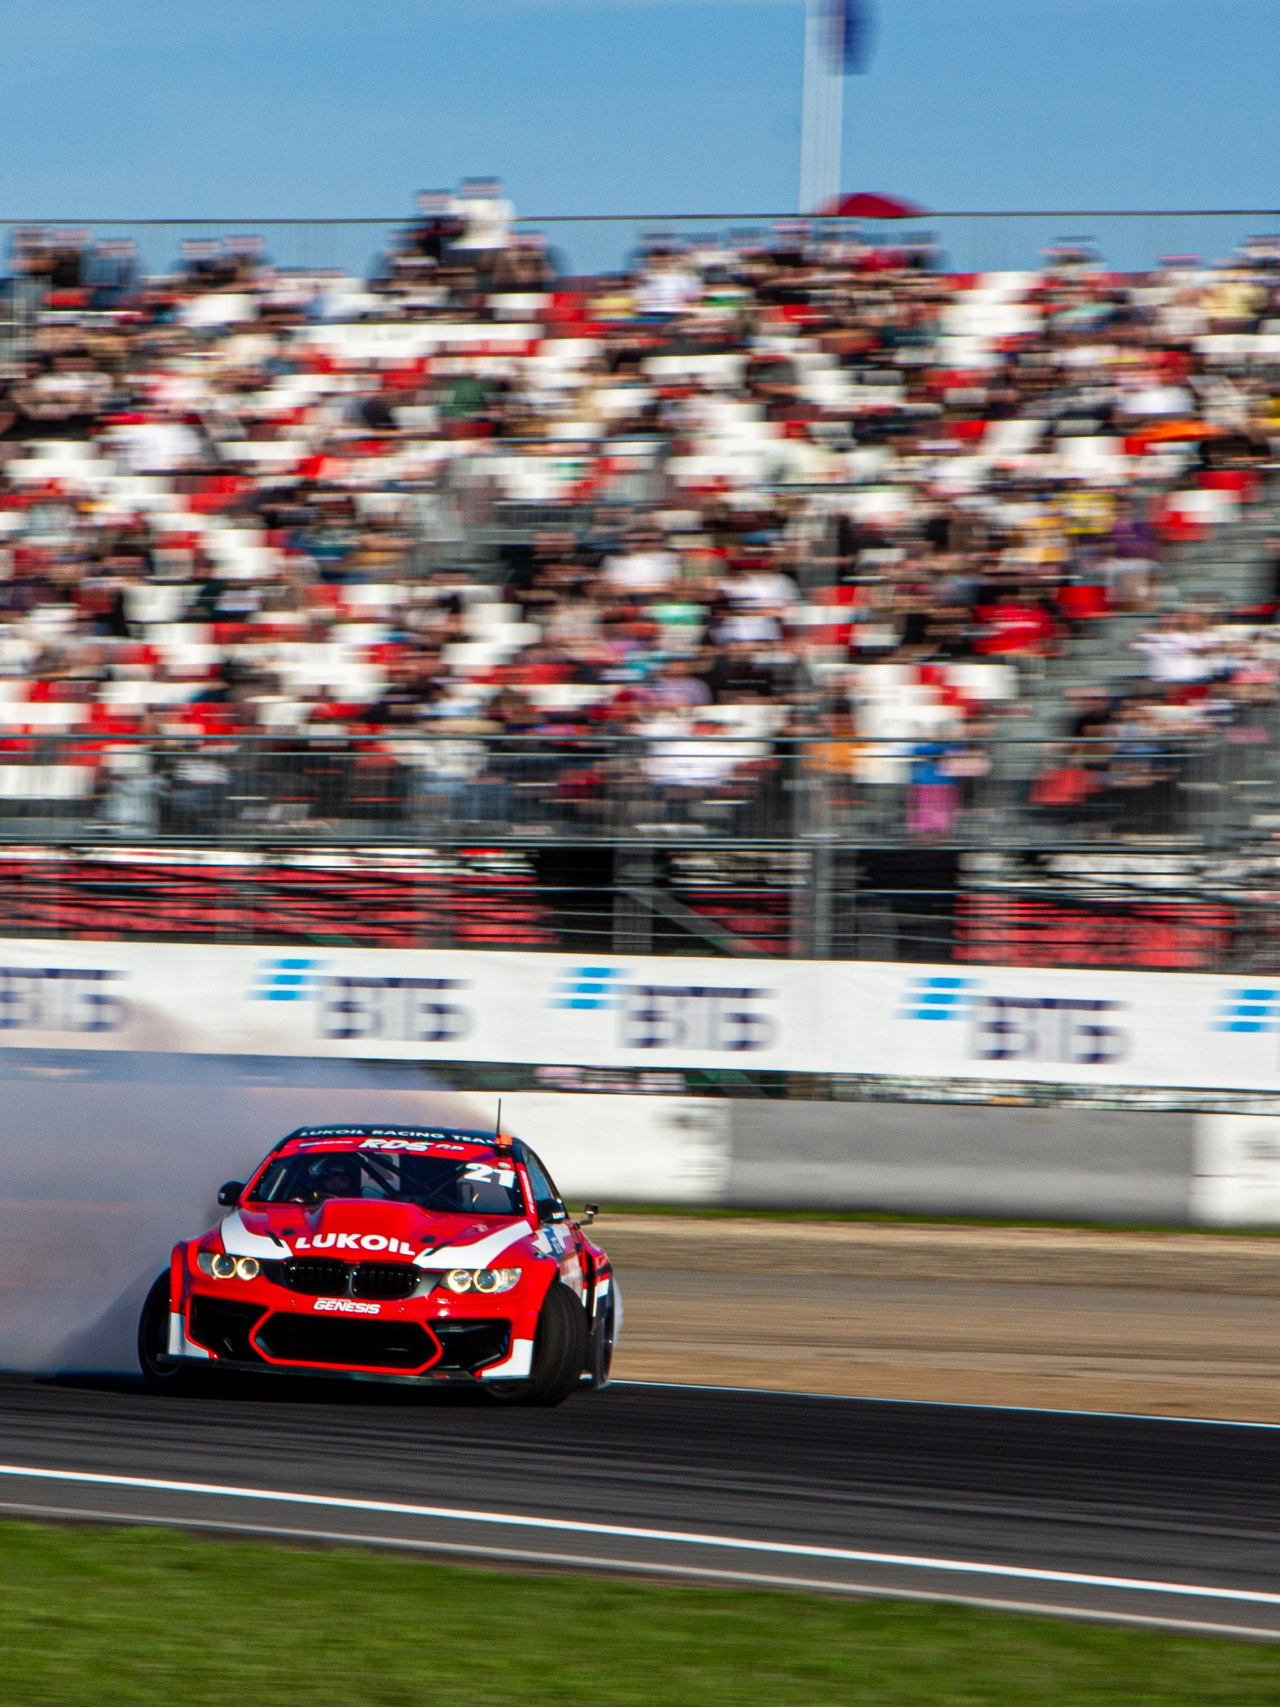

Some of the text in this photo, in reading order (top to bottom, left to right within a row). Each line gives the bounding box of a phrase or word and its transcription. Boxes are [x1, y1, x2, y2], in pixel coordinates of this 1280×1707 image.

[300, 1129, 365, 1137] LUKOIL
[371, 1129, 445, 1139] RACING
[358, 1139, 435, 1152] RDS
[464, 1163, 515, 1188] 21
[295, 1233, 416, 1256] LUKOIL
[313, 1300, 381, 1315] GENESIS
